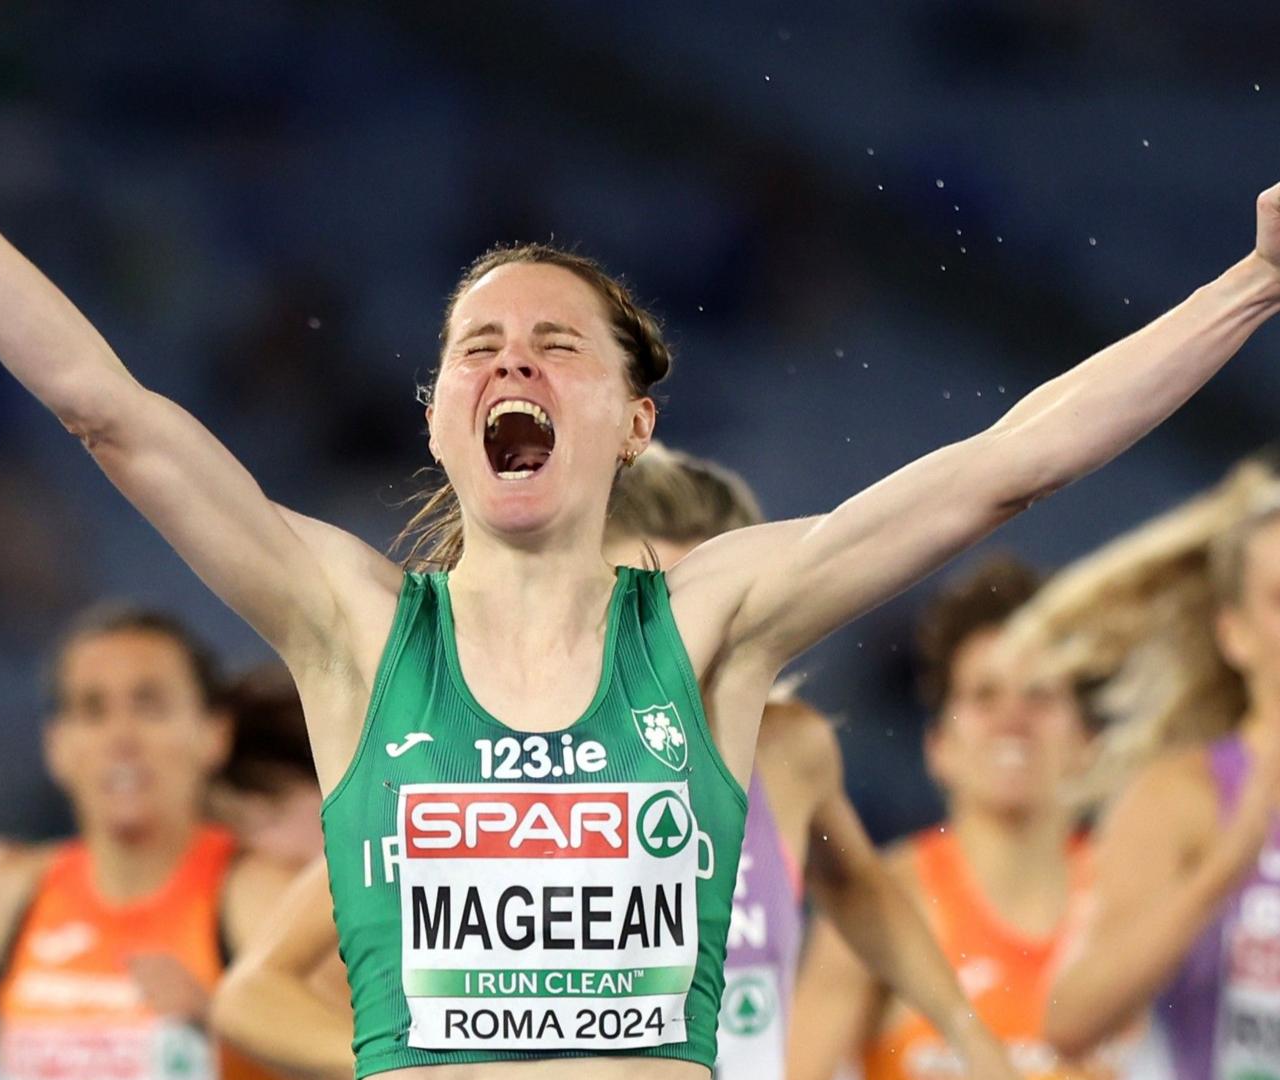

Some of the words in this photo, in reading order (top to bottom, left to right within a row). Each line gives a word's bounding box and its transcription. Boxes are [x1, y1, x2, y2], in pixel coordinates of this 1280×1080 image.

[474, 733, 608, 780] 123.ie
[411, 801, 623, 849] SPAR
[411, 883, 685, 951] MAGEEAN
[464, 972, 470, 994] I
[477, 972, 538, 994] RUN
[444, 1009, 565, 1040] ROMA
[575, 1007, 665, 1040] 2024
